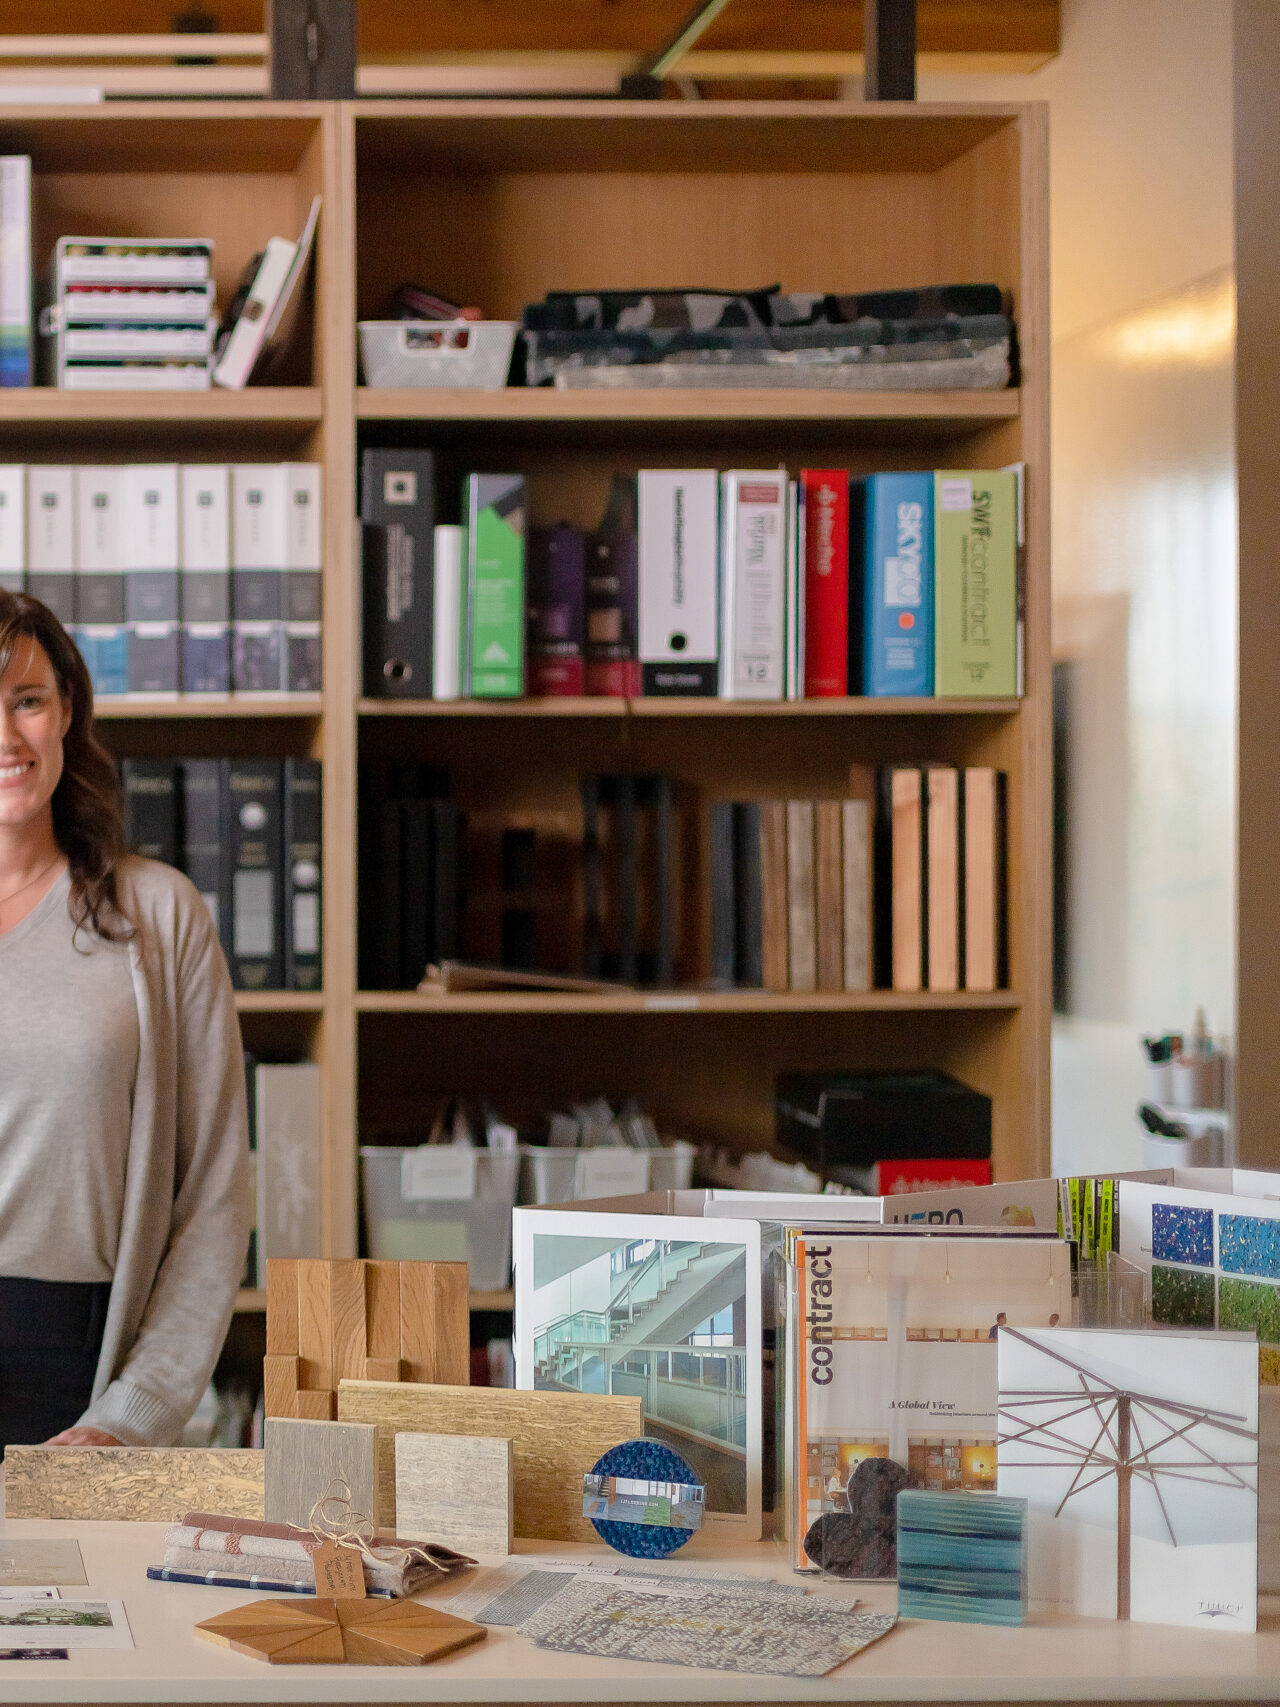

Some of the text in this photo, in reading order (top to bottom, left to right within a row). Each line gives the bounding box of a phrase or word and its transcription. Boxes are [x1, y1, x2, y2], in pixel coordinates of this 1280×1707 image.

[895, 500, 923, 607] SKYCO
[805, 1246, 834, 1386] contract
[888, 1399, 956, 1410] A Global View
